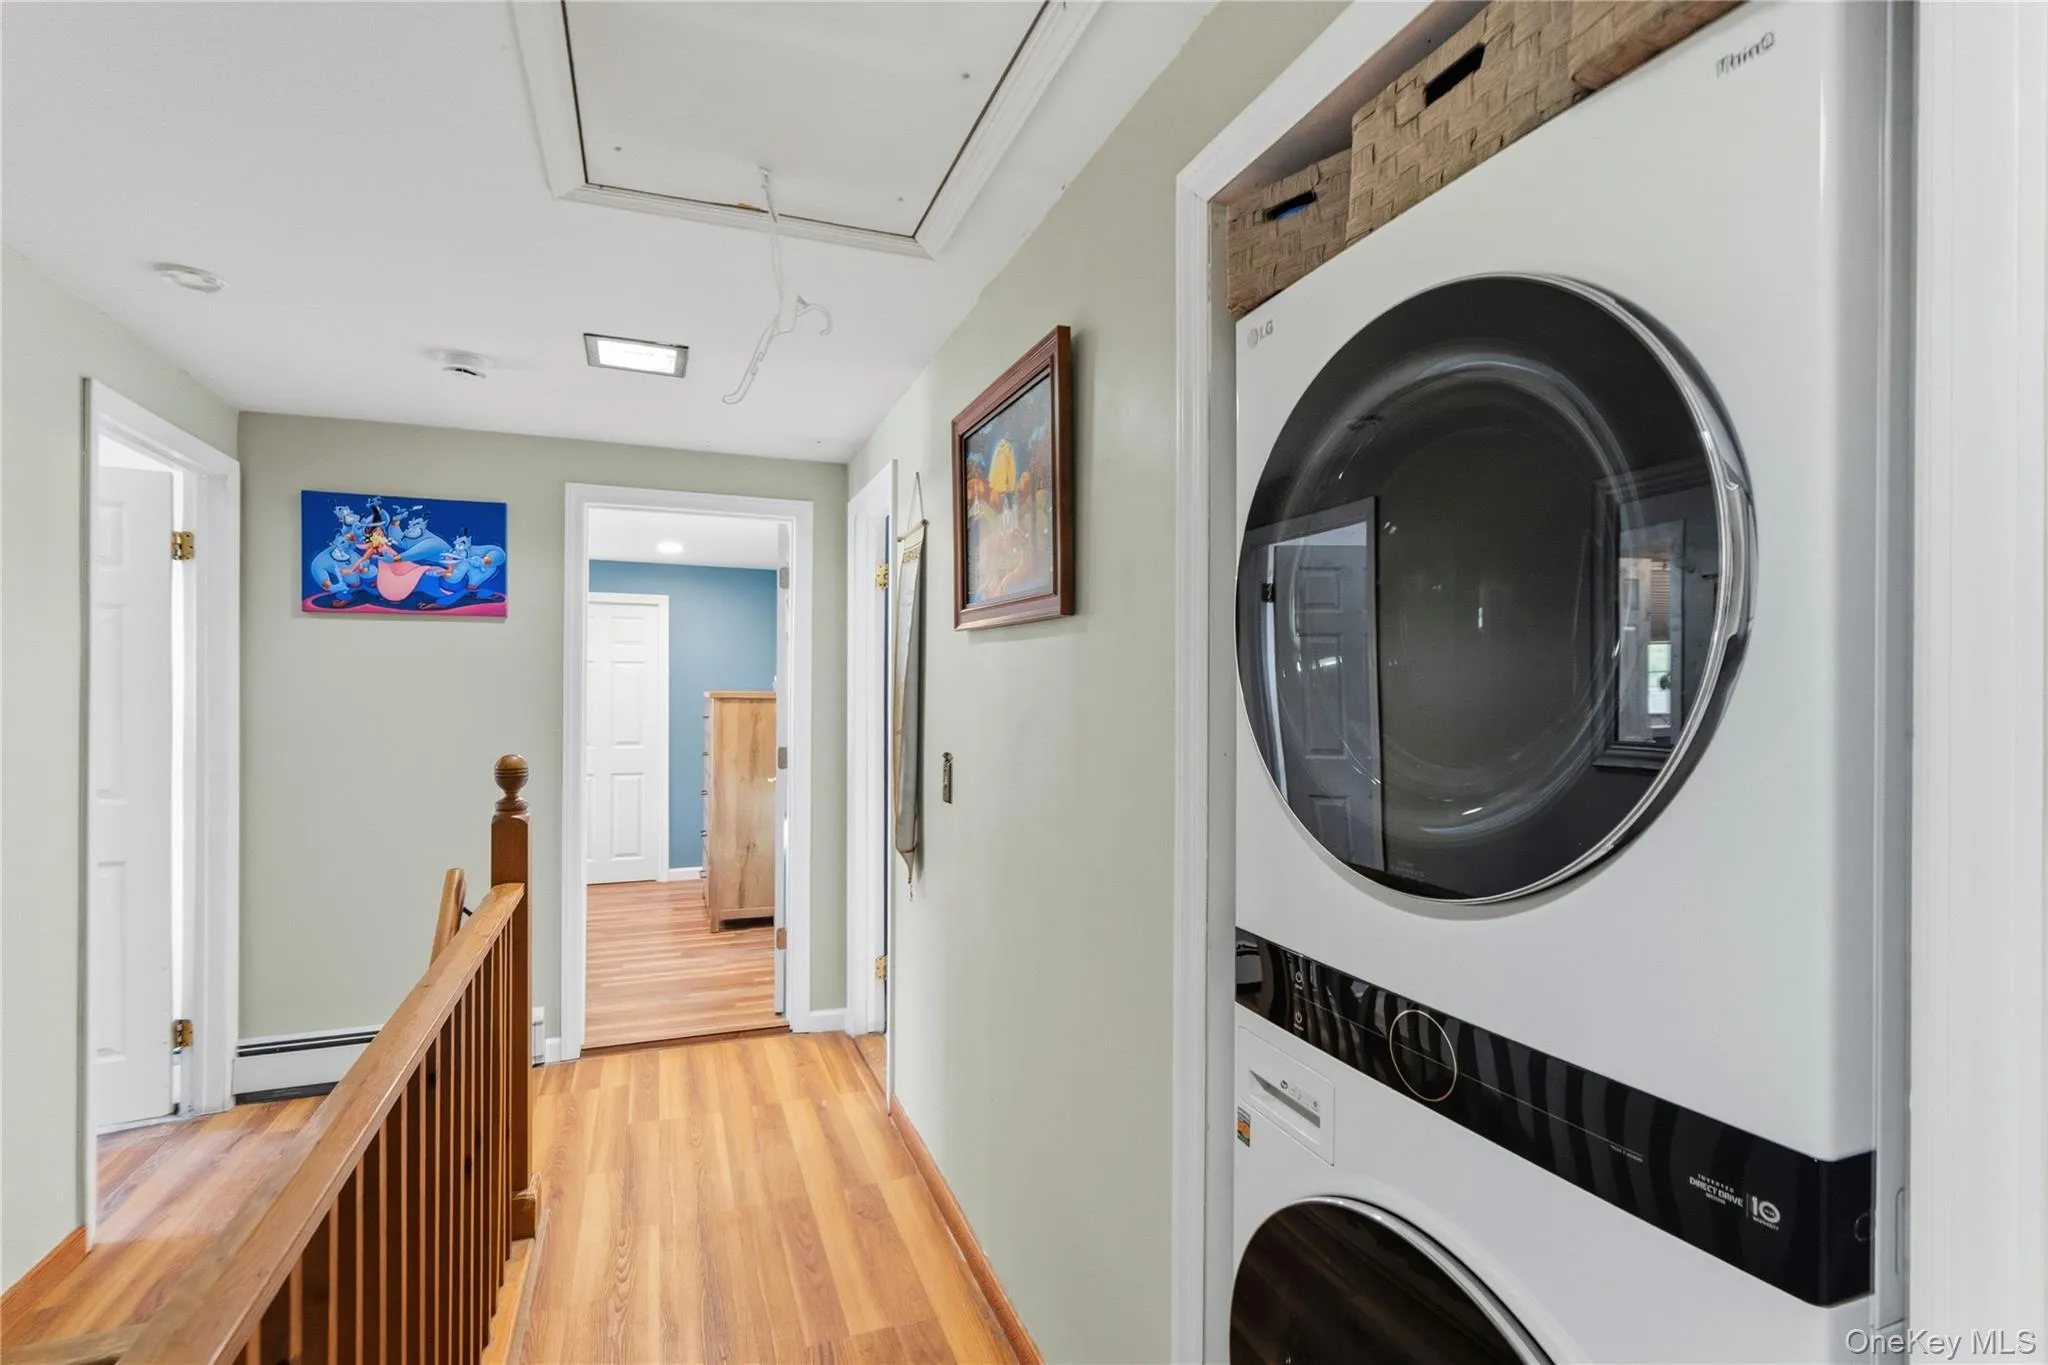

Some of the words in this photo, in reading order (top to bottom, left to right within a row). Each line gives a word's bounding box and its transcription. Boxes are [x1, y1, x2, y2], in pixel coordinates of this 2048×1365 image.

[1689, 1176, 1717, 1195] DIRECT
[1718, 1189, 1744, 1207] DRIVE
[1751, 1195, 1781, 1223] 10
